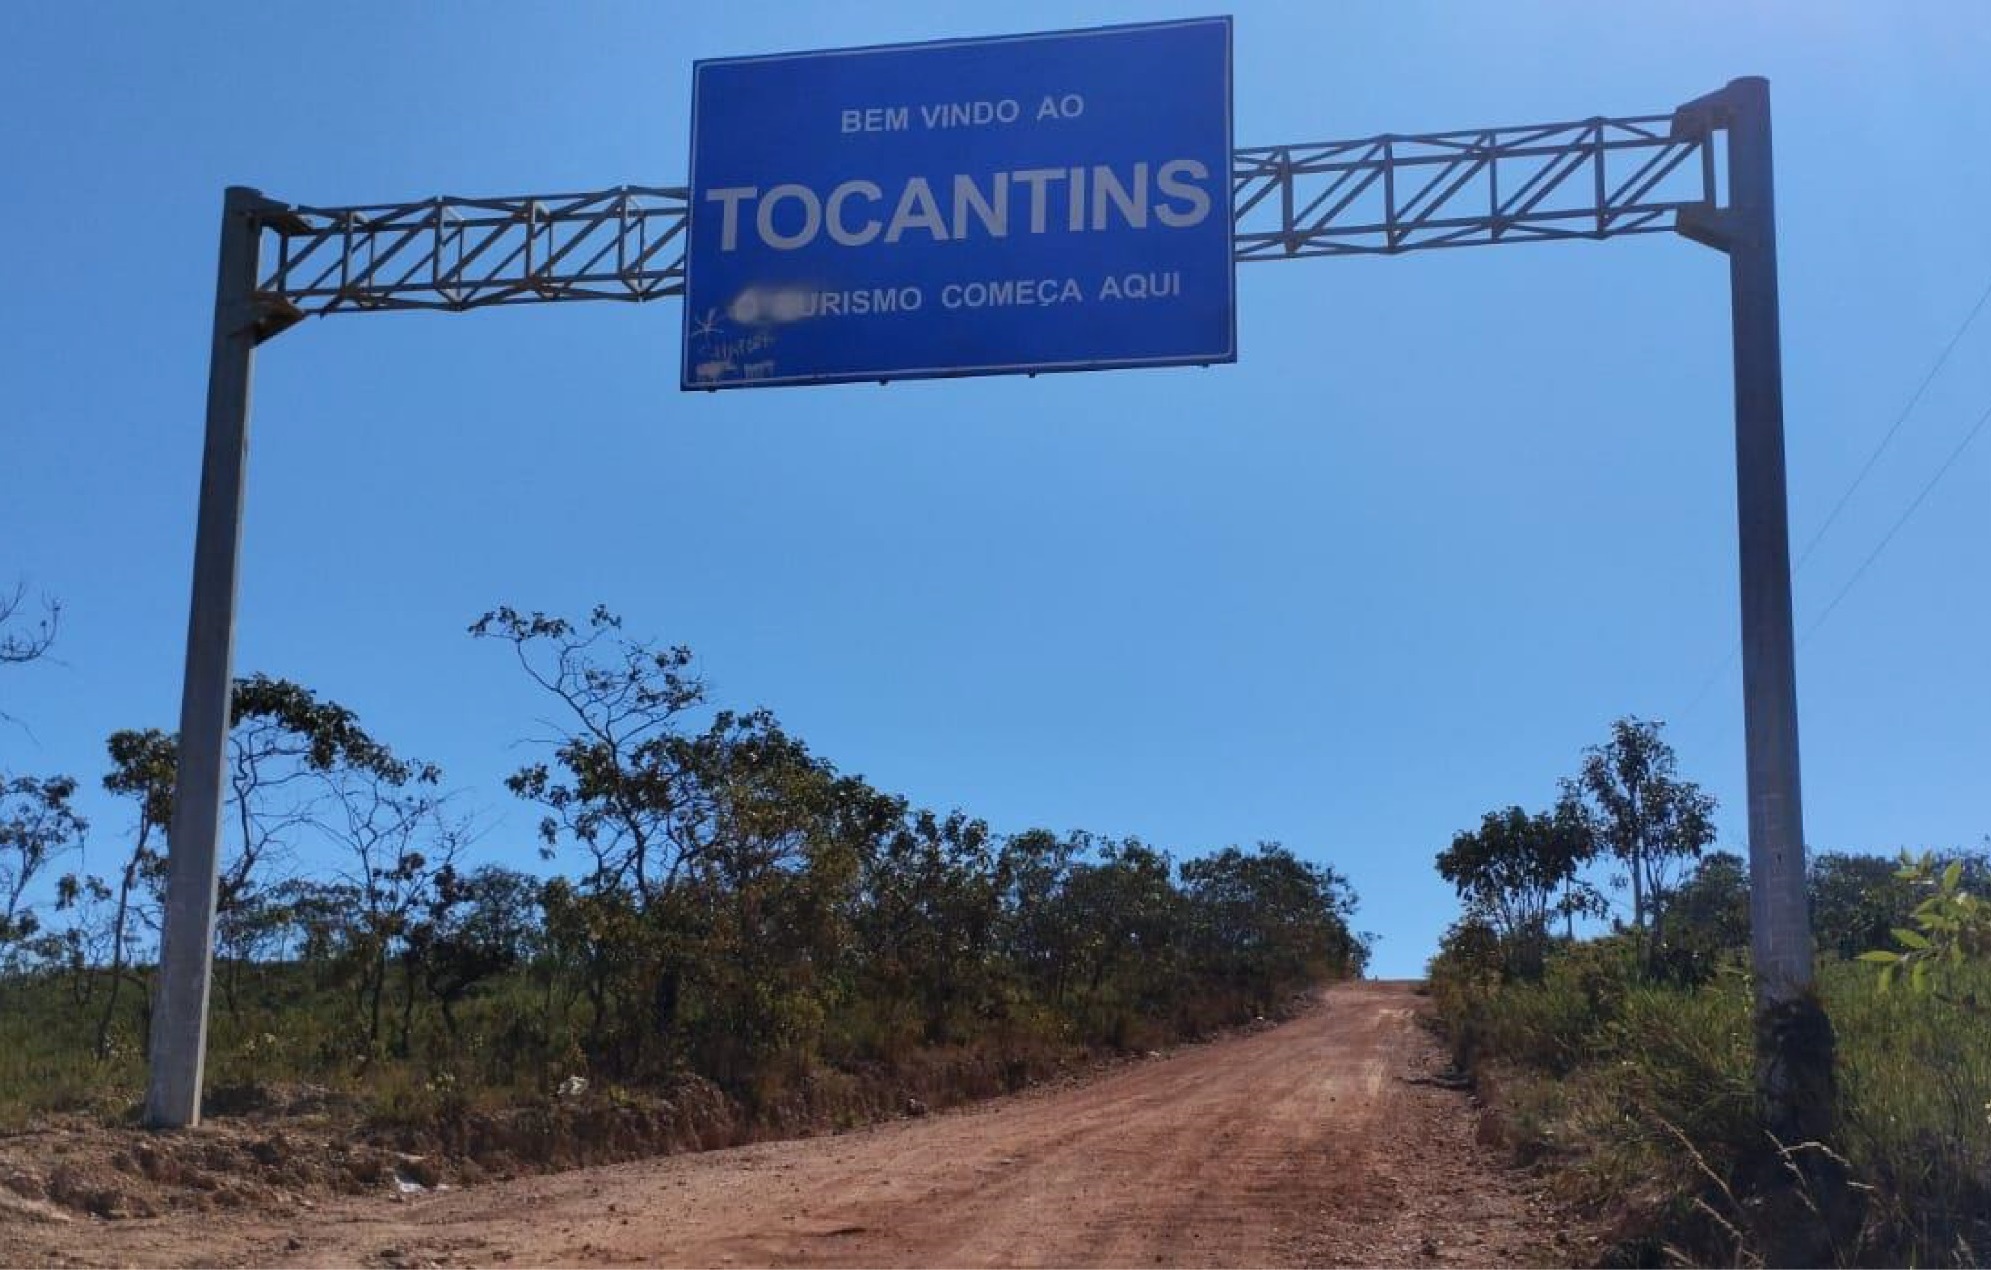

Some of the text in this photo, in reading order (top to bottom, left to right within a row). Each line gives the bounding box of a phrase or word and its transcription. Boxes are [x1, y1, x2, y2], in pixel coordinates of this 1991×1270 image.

[841, 93, 1084, 133] BEM VINDO AO
[706, 159, 1211, 251] TOCANTINS
[777, 286, 922, 317] URISMO
[941, 278, 1082, 308] COMEÇA
[1100, 271, 1180, 299] AQUI
